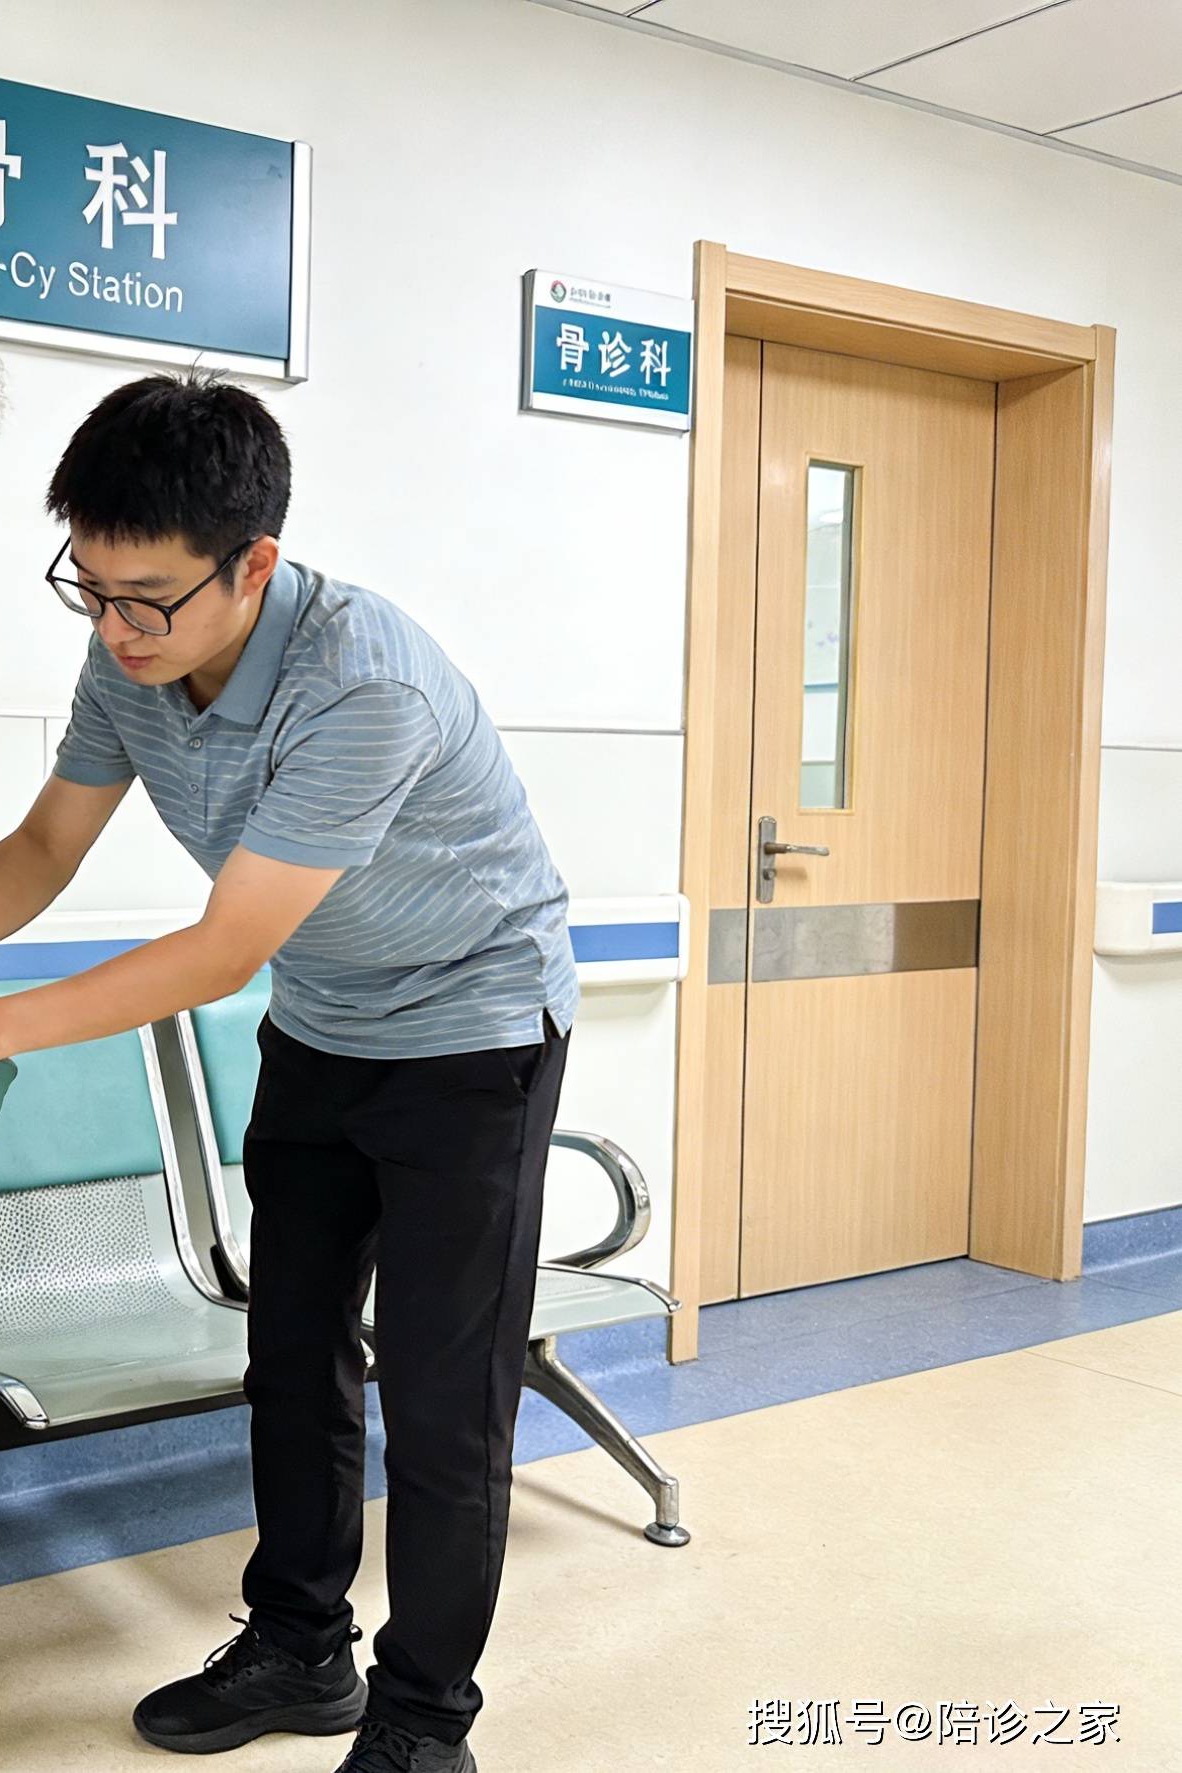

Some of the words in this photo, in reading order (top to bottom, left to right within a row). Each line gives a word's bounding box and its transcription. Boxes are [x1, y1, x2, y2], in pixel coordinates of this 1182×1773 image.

[67, 261, 184, 313] Station
[555, 322, 672, 387] 骨诊科
